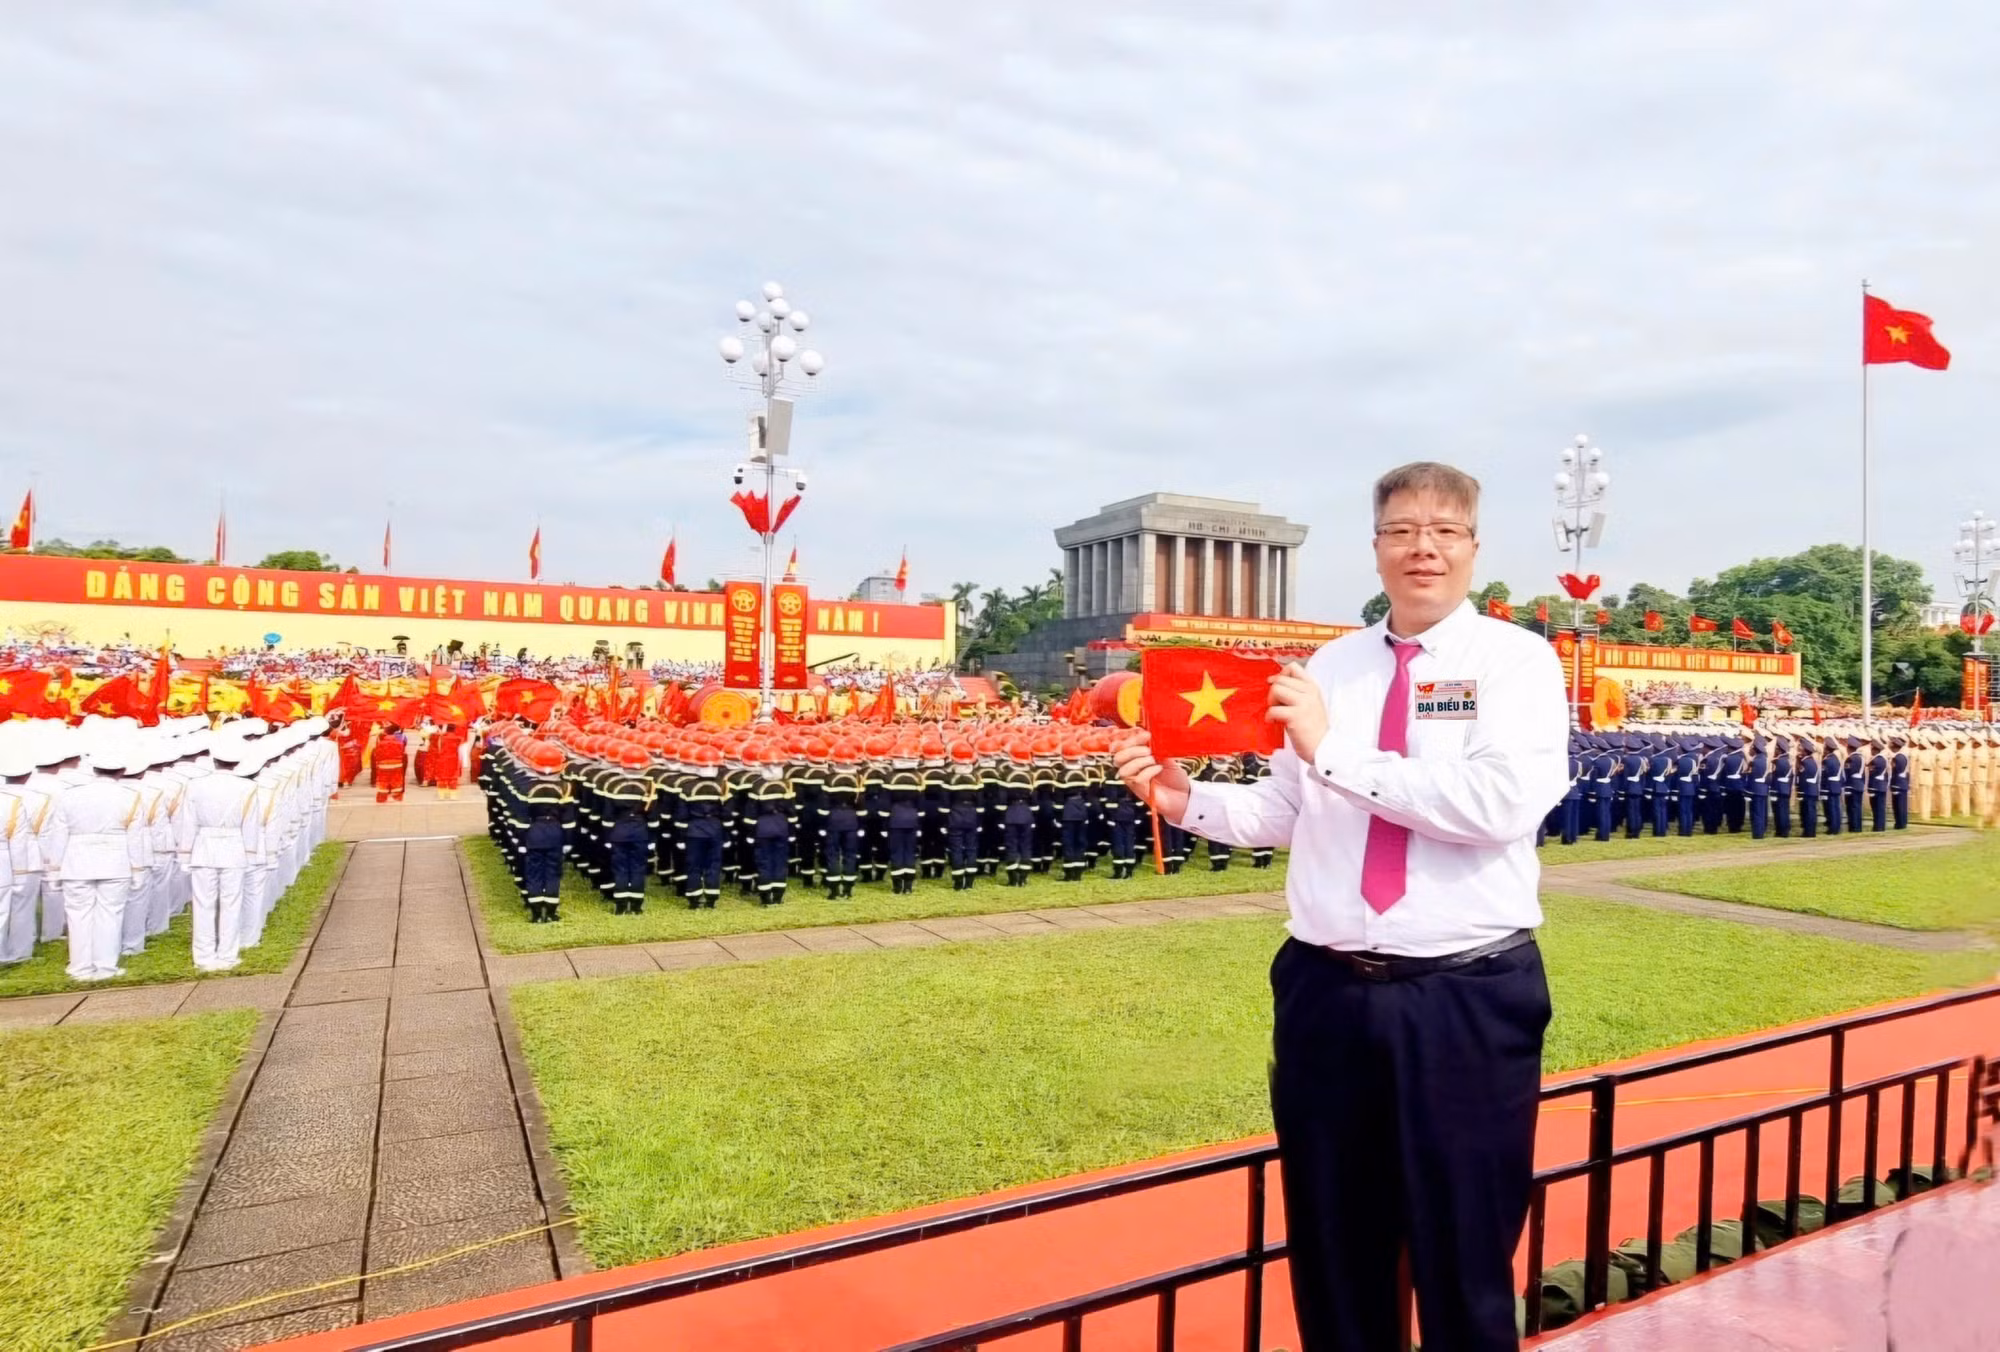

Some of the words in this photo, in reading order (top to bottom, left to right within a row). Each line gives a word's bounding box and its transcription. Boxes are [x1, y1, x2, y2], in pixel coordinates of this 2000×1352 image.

[206, 573, 299, 610] CỘNG
[318, 577, 380, 610] SẢN
[399, 584, 466, 618] VIỆT
[483, 590, 543, 618] NAM
[559, 594, 649, 624] QUANG
[1417, 702, 1435, 714] ĐẠI
[1437, 696, 1460, 712] BIỂU
[1462, 700, 1476, 711] B2
